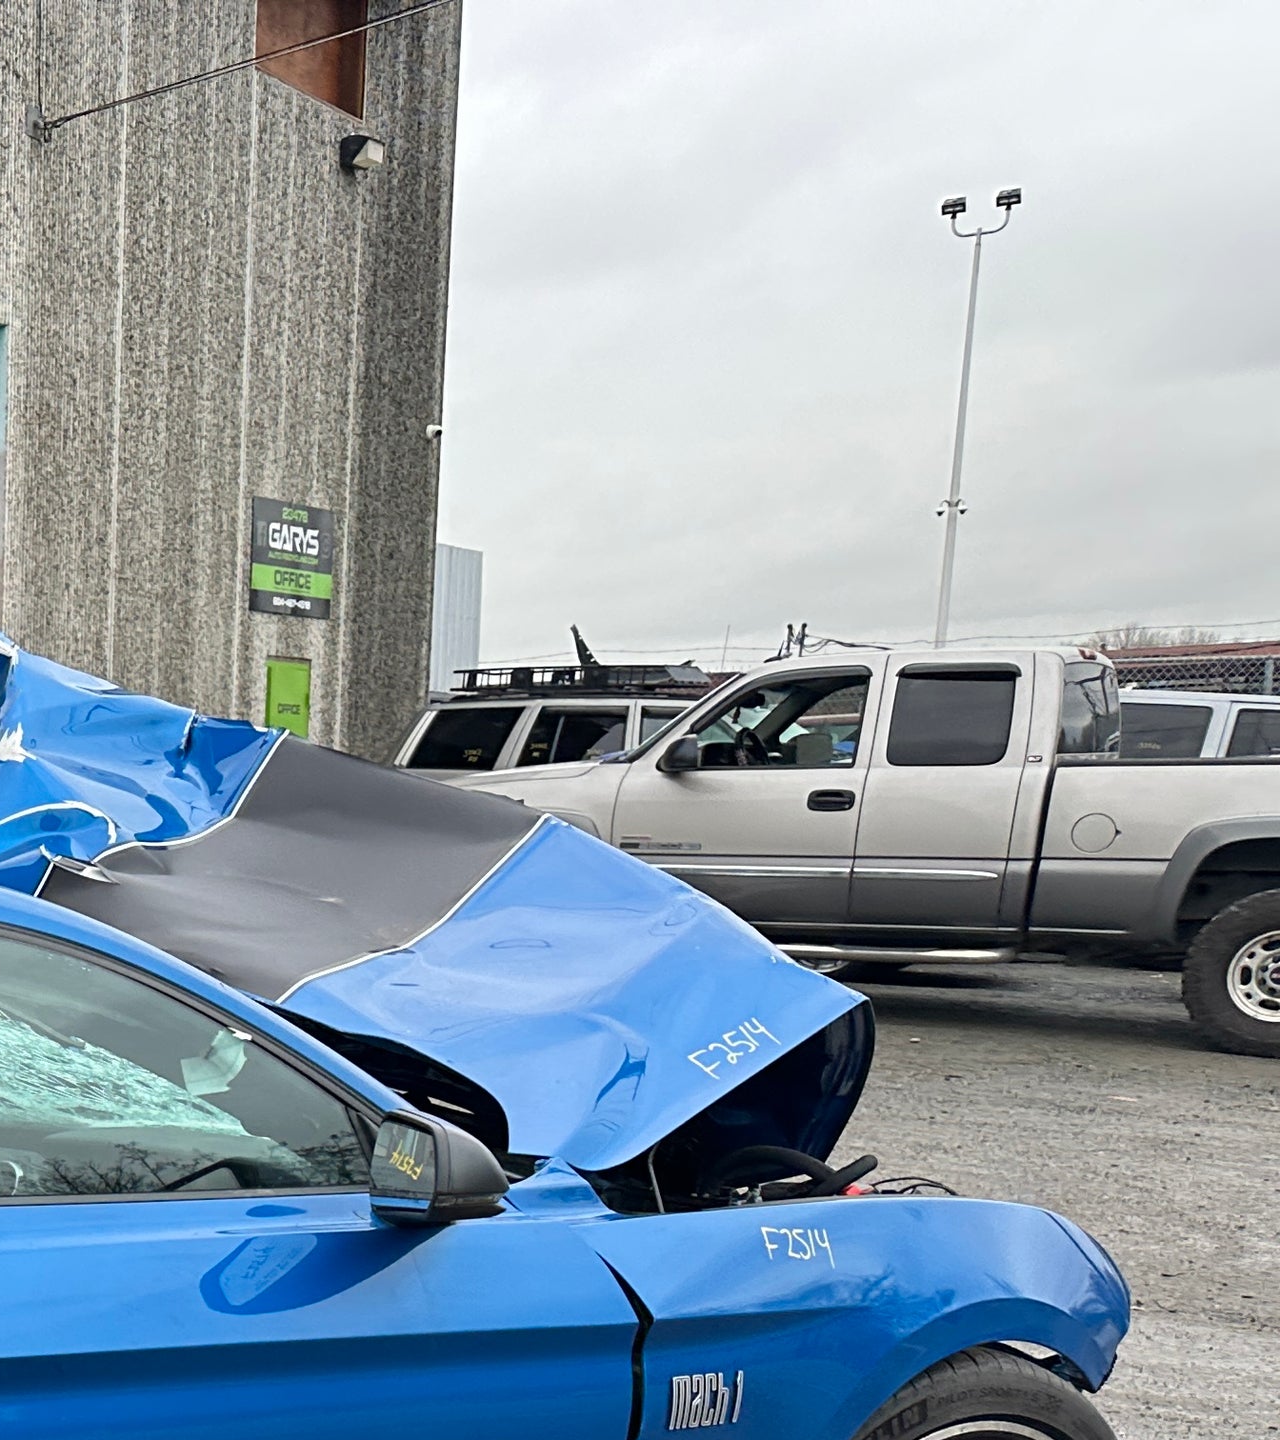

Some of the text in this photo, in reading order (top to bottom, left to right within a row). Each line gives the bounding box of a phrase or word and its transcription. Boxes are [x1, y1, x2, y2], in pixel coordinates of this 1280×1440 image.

[268, 522, 319, 556] GARYS
[274, 569, 311, 590] OFFICE
[687, 1017, 781, 1080] F2514
[389, 1138, 424, 1180] F2514
[760, 1226, 835, 1269] F2514
